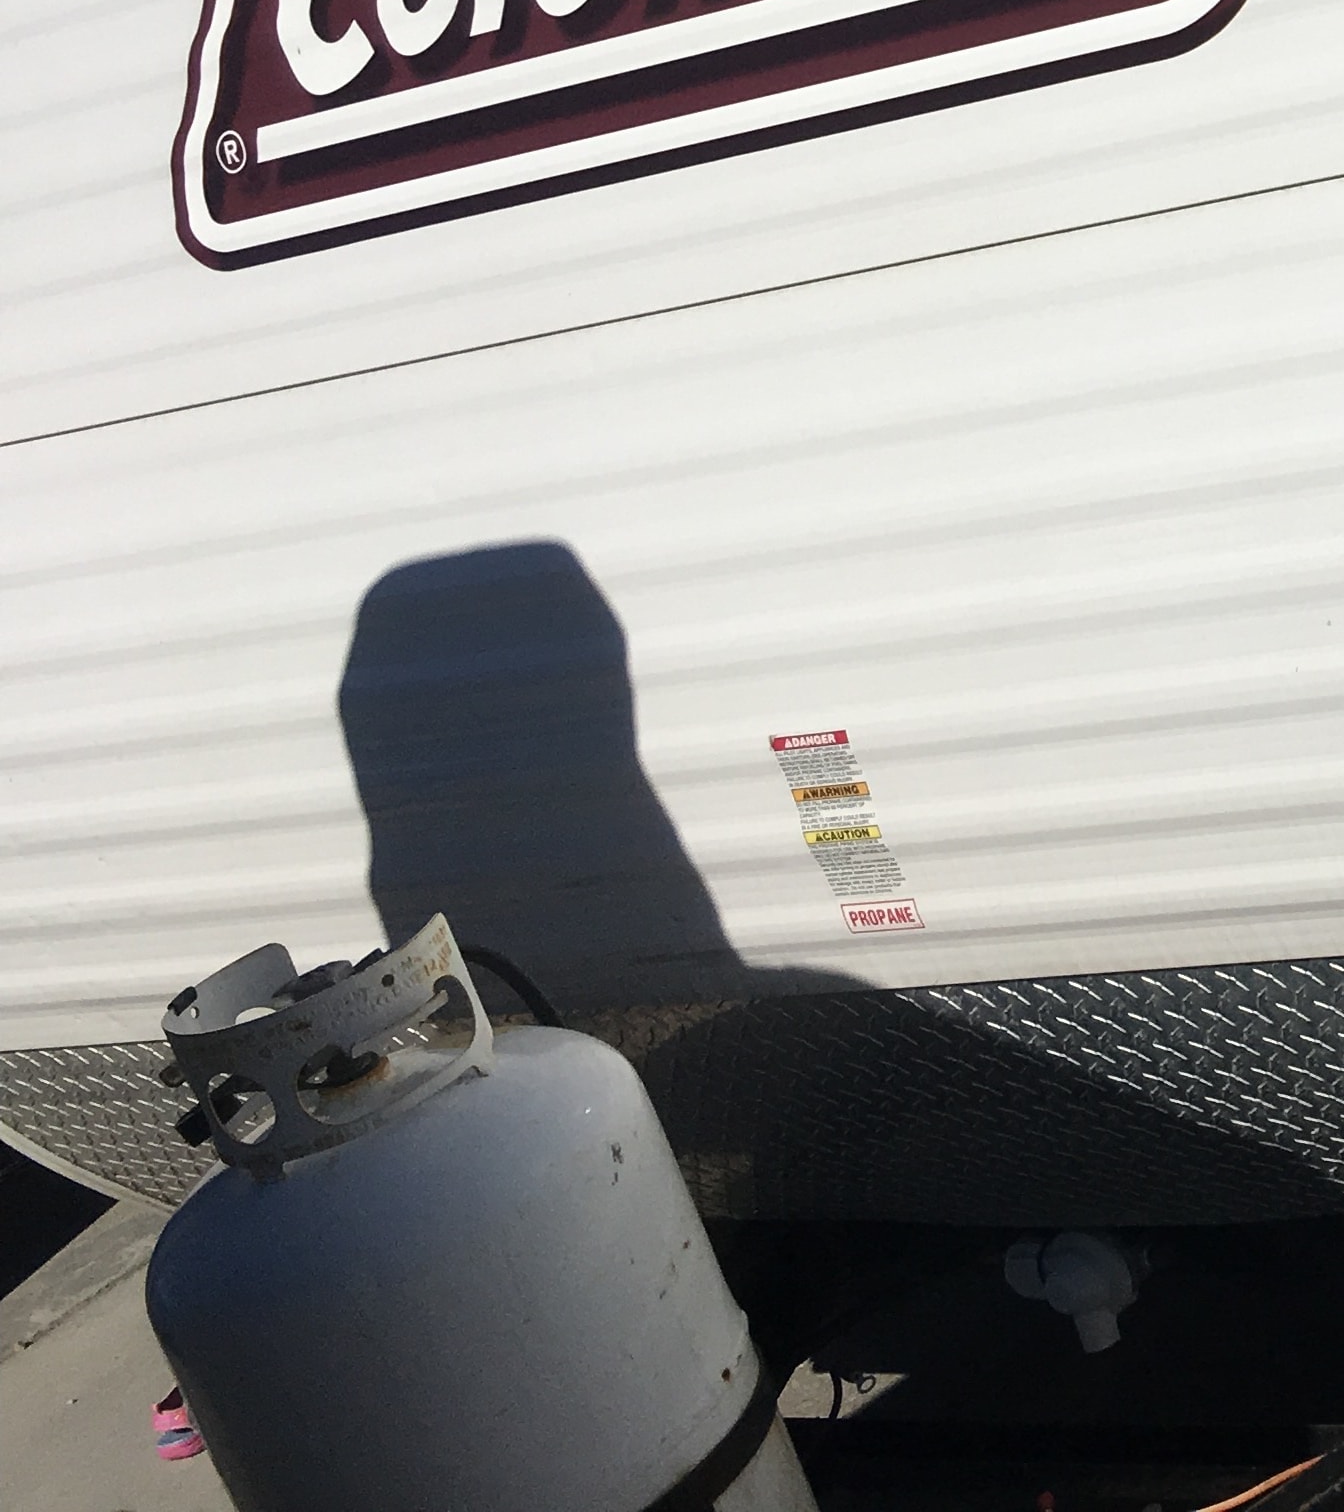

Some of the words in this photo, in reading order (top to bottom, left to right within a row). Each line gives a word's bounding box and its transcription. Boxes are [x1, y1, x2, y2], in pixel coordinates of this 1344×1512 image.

[791, 734, 837, 748] DANGER
[808, 784, 860, 799] WARNING
[822, 828, 871, 842] CAUTION
[848, 906, 917, 928] PROPANE
